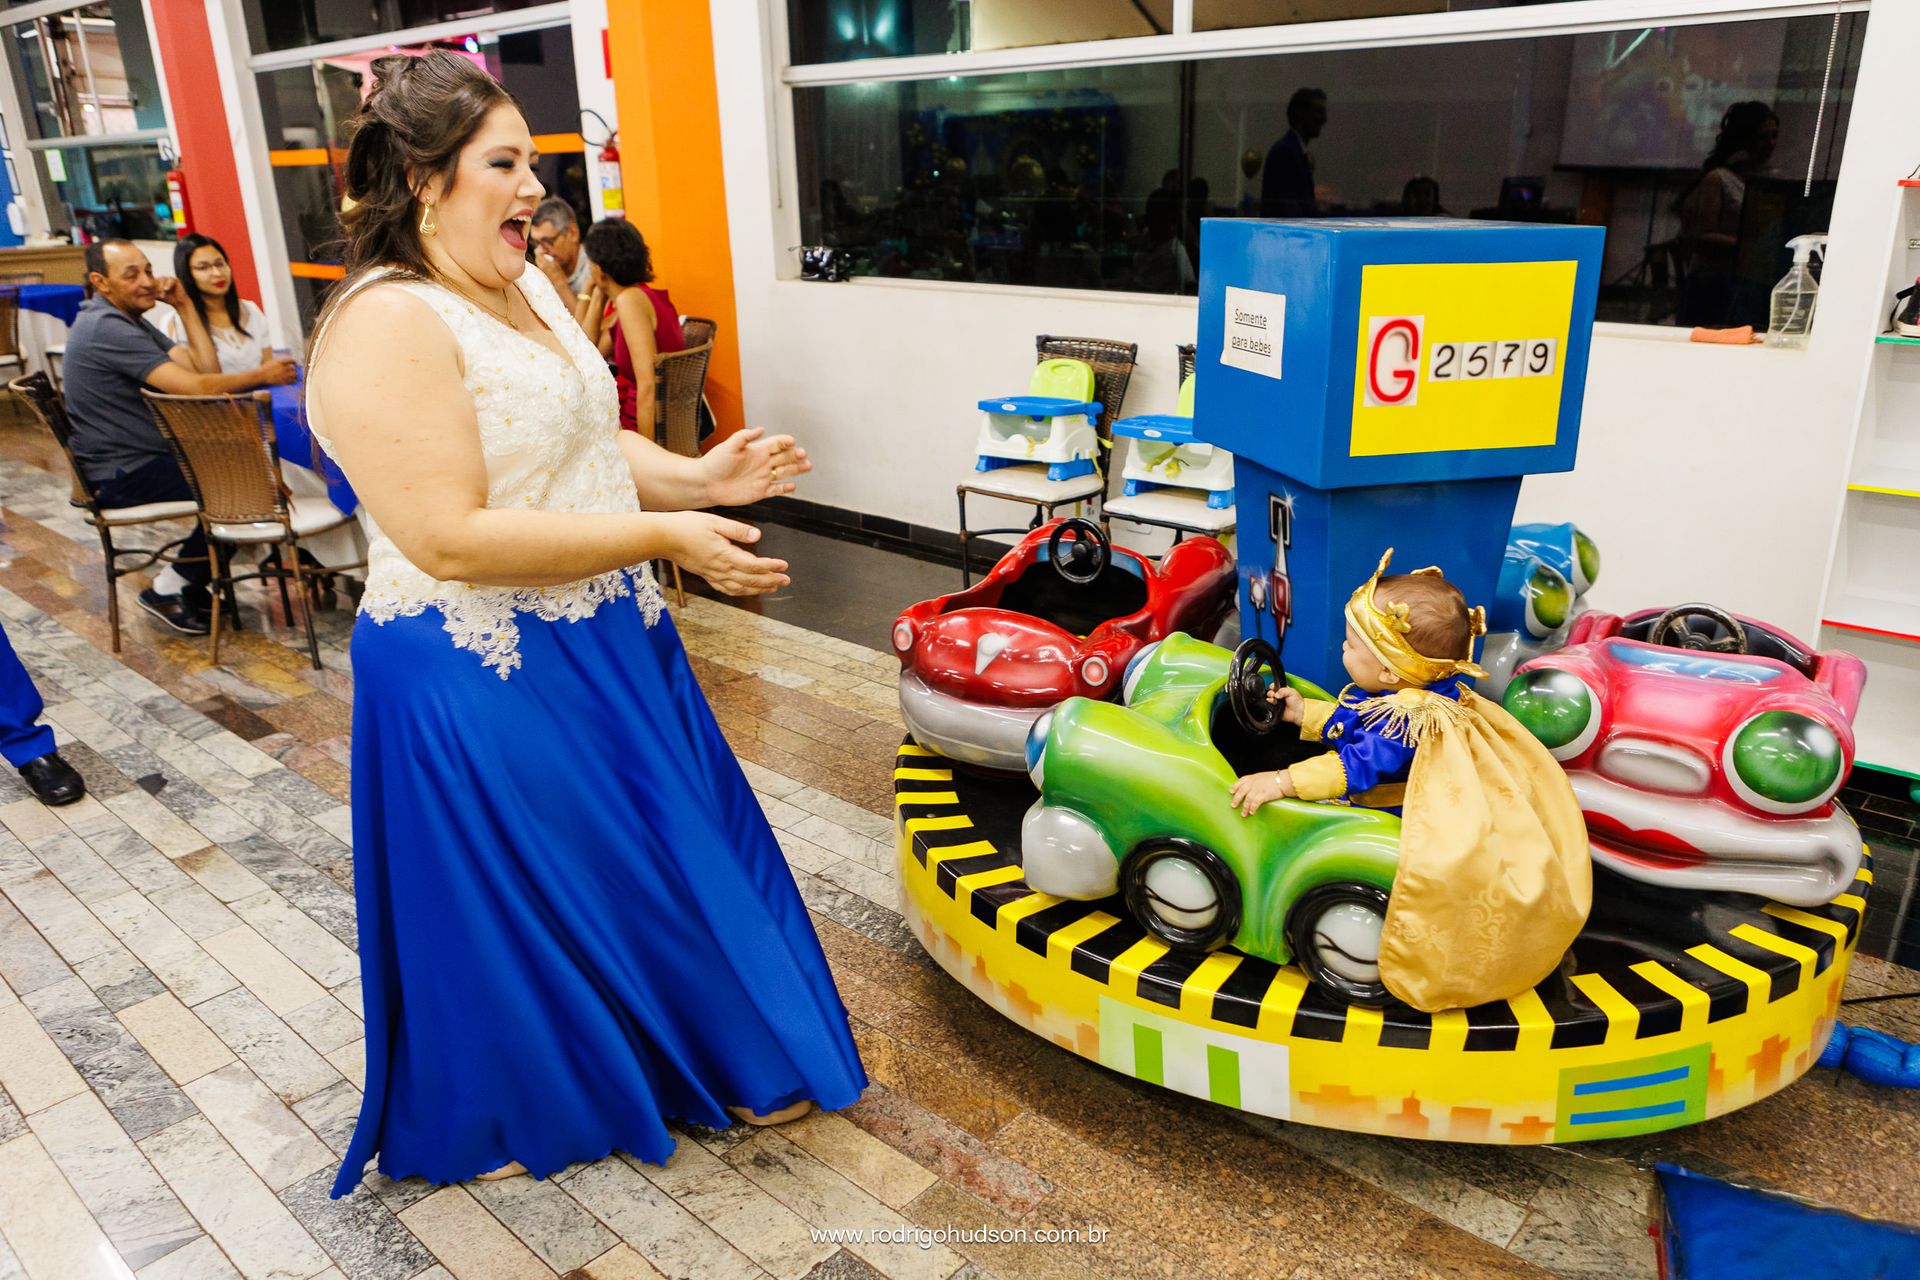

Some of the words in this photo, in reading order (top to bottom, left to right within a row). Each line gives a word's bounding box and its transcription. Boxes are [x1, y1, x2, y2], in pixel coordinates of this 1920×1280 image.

[1234, 307, 1268, 328] Somente
[1231, 336, 1248, 350] para
[1369, 318, 1419, 403] G
[1433, 342, 1549, 379] 2579
